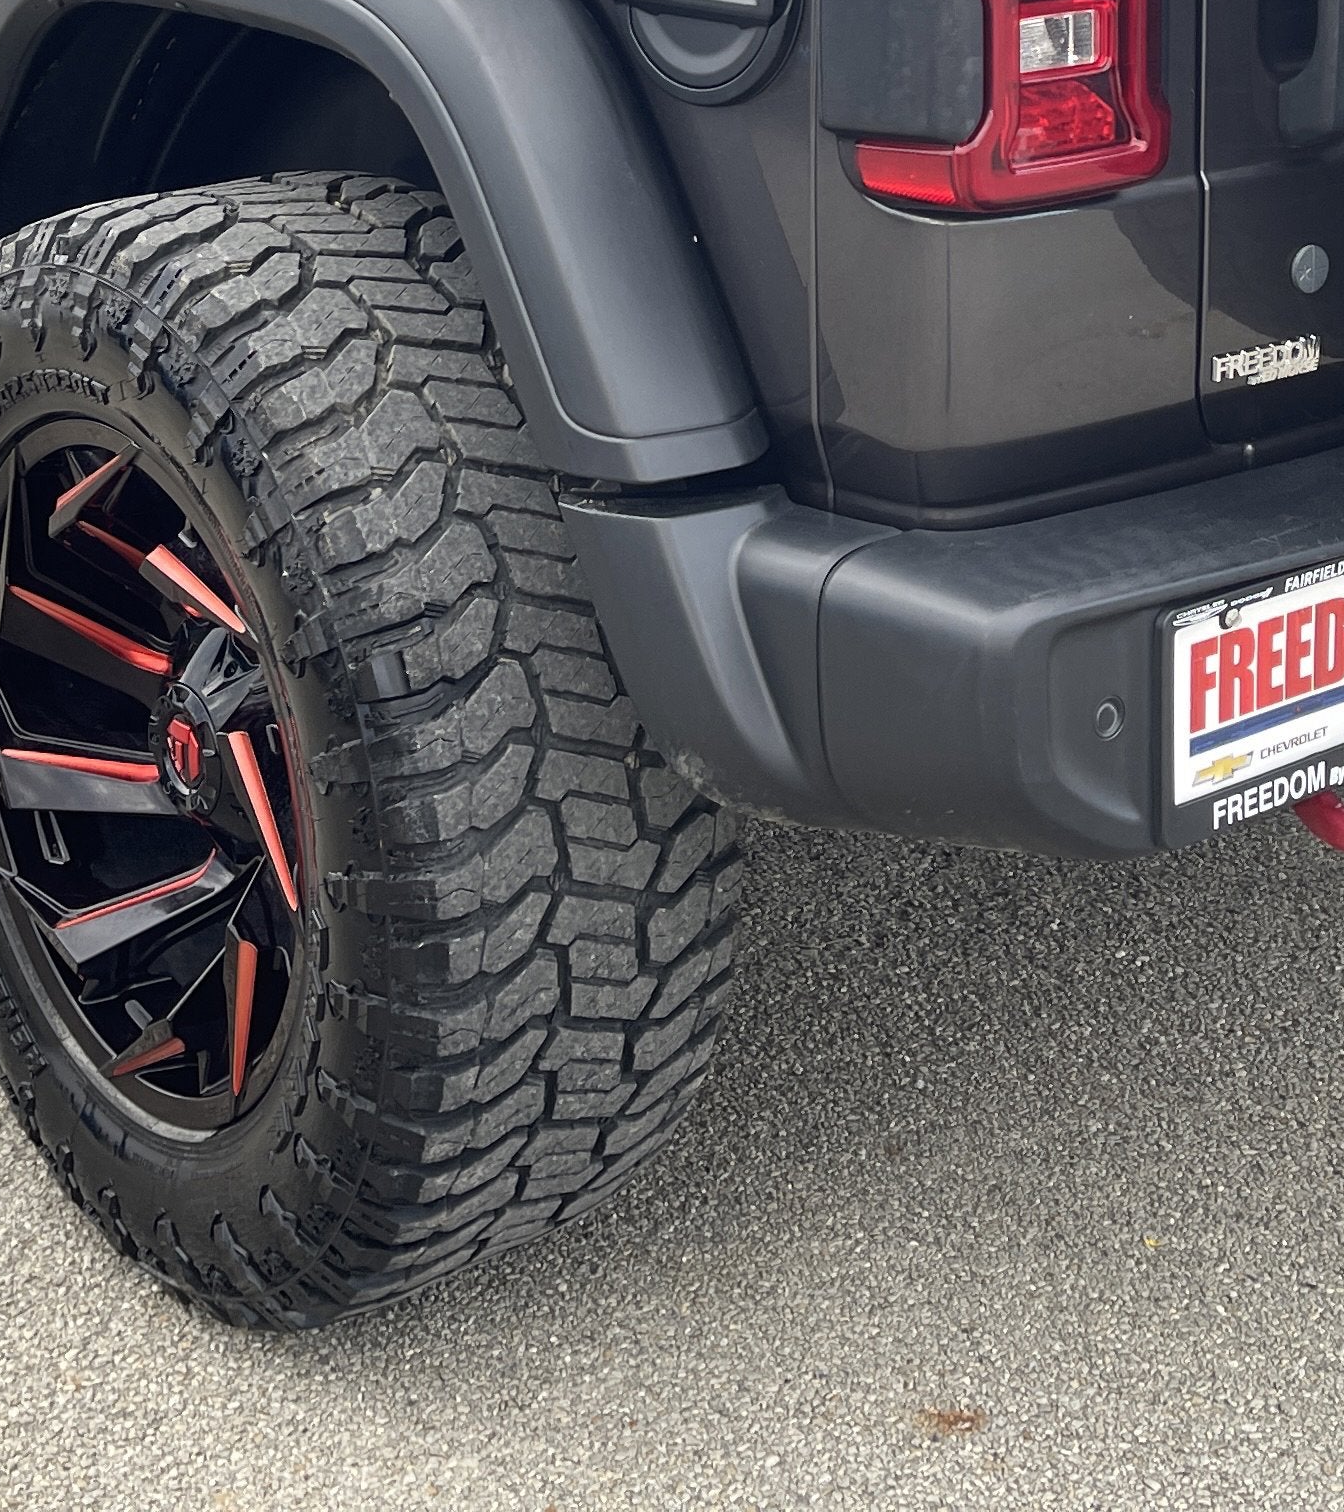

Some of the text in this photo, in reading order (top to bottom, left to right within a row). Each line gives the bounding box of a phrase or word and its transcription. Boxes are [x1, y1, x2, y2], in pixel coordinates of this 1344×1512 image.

[1212, 334, 1320, 382] FREEDOM
[1260, 726, 1328, 760] CHEVROLET
[1213, 760, 1326, 830] FREEDOM
